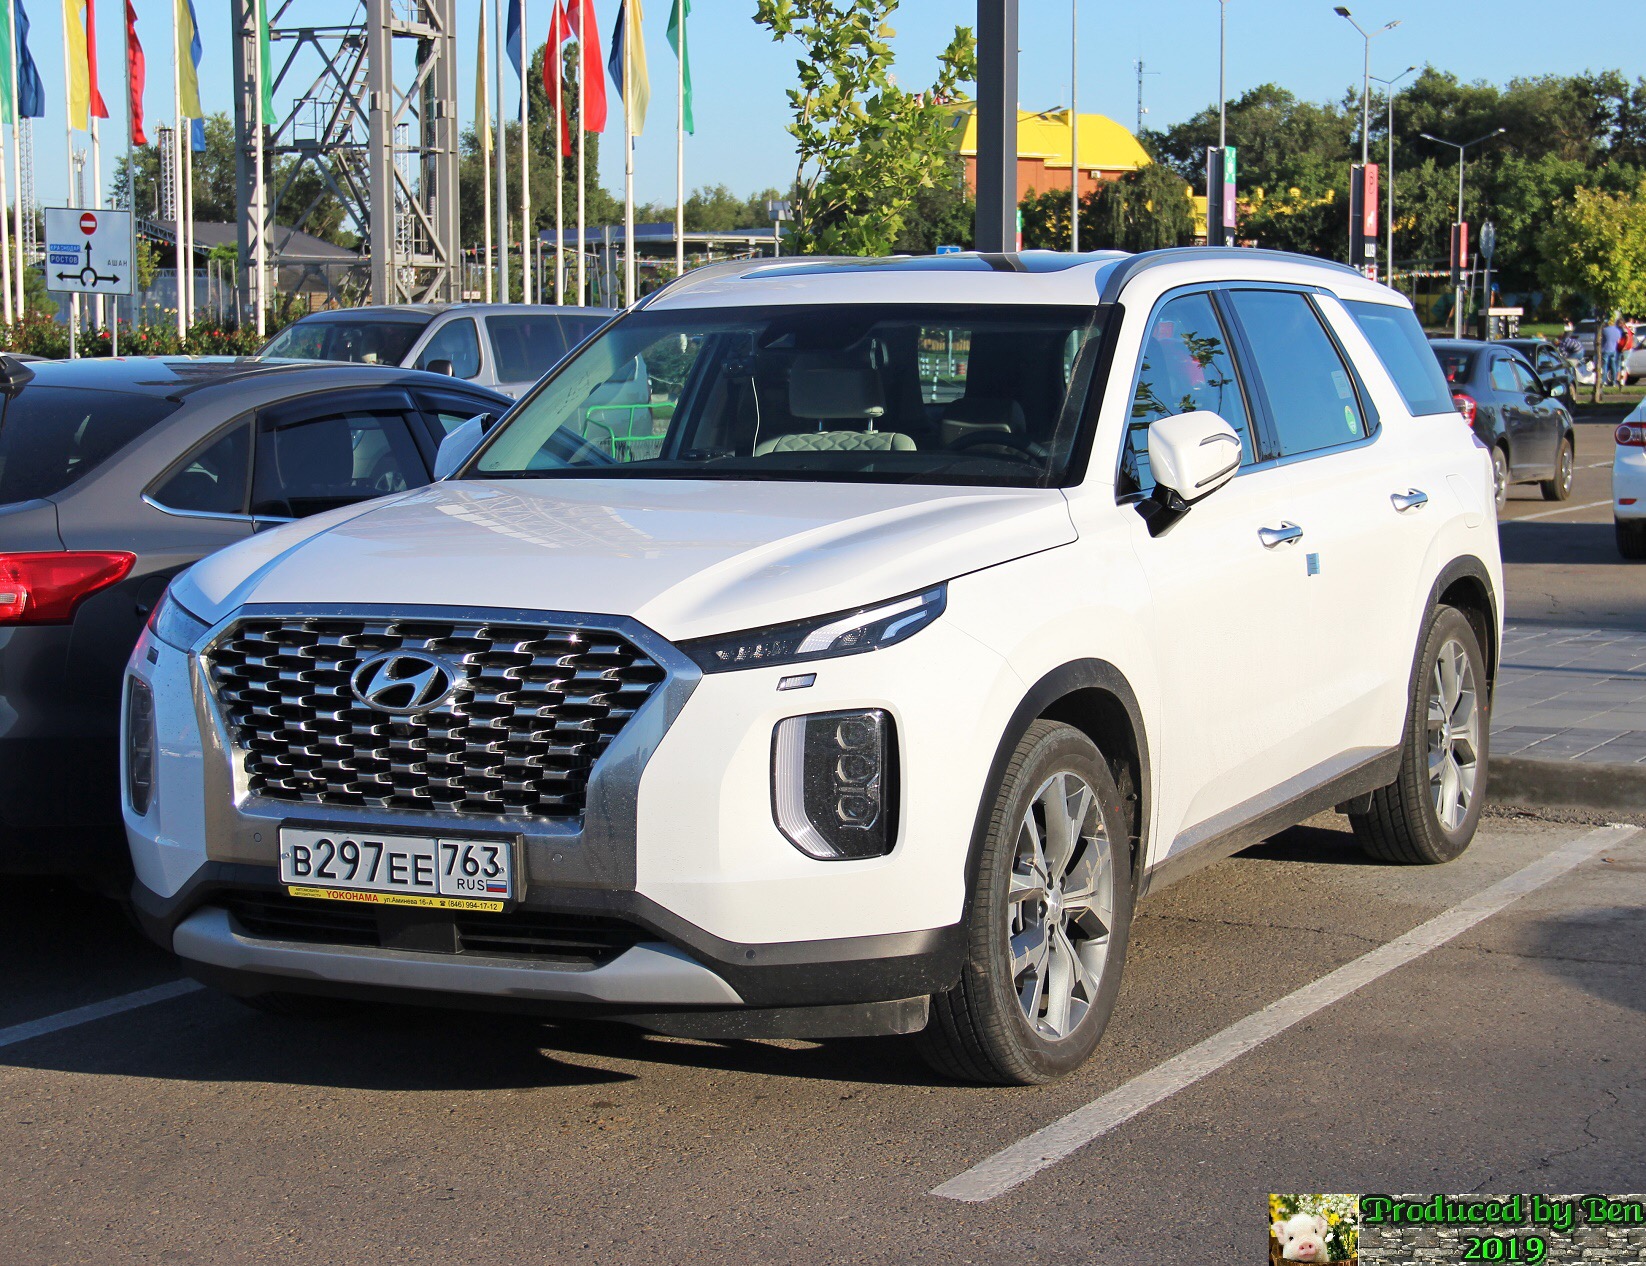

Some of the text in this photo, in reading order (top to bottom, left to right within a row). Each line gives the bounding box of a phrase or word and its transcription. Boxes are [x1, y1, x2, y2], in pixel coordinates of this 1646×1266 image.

[51, 255, 78, 264] РОСТОВ
[107, 259, 128, 267] АШАН
[293, 838, 500, 886] В297ЕЕ 763
[457, 879, 485, 891] RUS
[326, 890, 379, 902] YOKOHAMA
[448, 900, 465, 908] (846)
[466, 901, 498, 911] 994-17-12
